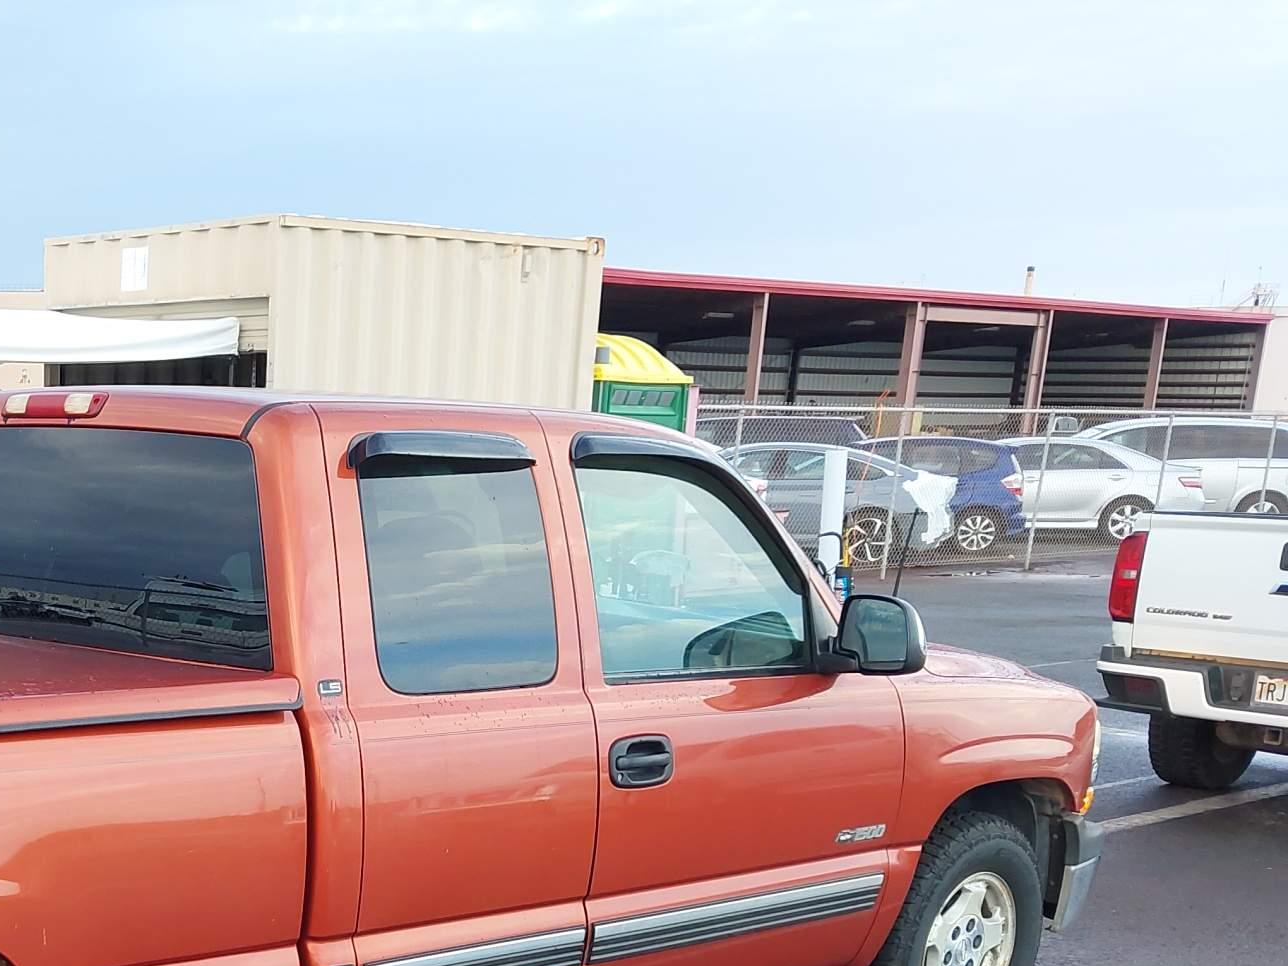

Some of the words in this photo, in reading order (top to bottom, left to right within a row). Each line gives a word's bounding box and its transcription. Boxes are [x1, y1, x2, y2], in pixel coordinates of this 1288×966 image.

[1146, 606, 1208, 618] COLORADO
[319, 681, 342, 694] LS
[1257, 681, 1288, 702] TRJ
